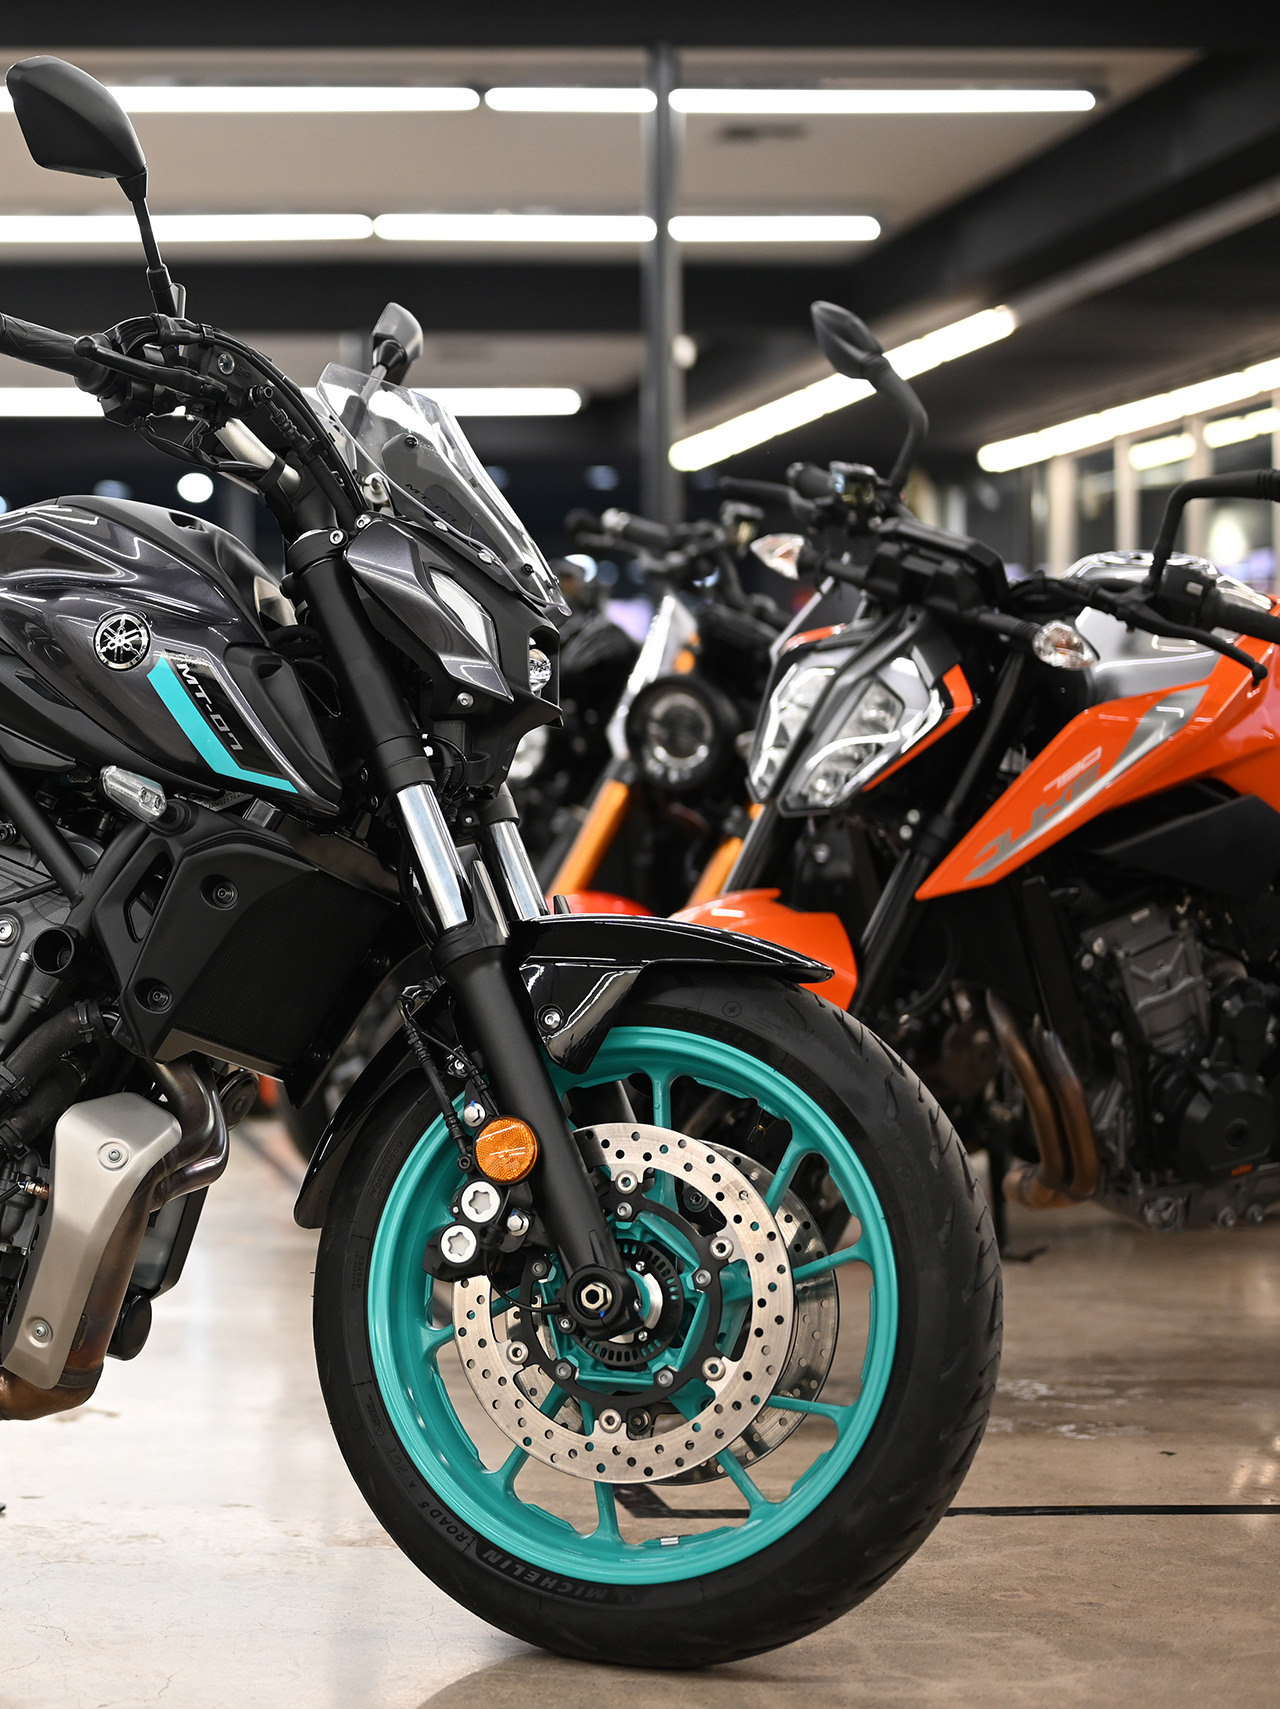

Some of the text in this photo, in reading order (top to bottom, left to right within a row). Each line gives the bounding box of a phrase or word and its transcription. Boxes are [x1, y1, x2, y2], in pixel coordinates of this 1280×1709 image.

[405, 483, 458, 522] MT-07
[176, 662, 245, 752] MT-07
[430, 1509, 472, 1545] ROAD
[482, 1548, 610, 1601] MICHELIN
